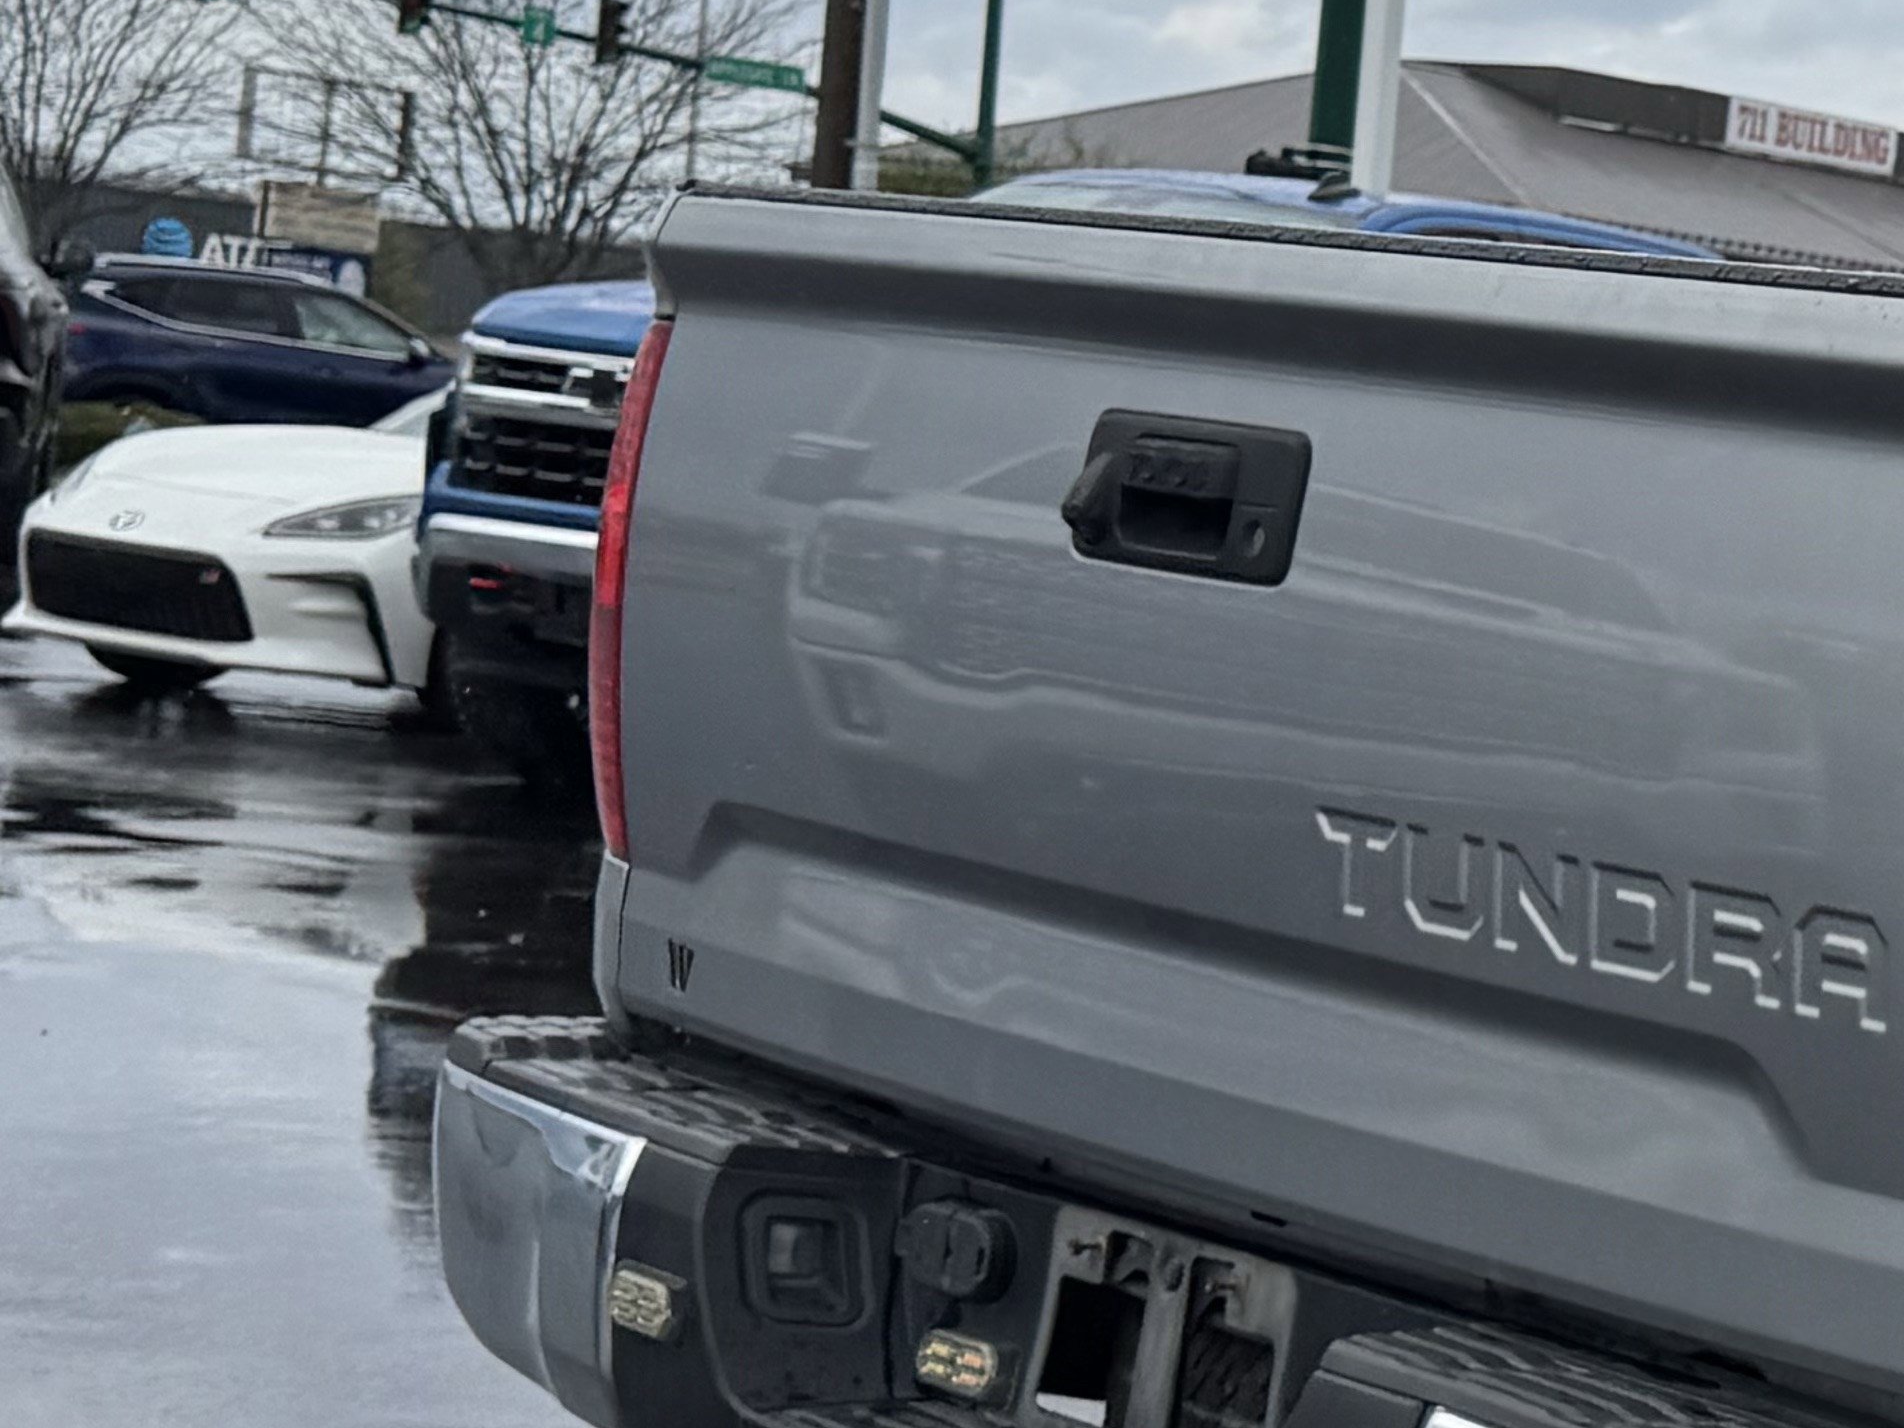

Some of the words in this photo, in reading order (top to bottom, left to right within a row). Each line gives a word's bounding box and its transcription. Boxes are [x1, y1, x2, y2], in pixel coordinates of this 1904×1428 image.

[1738, 104, 1768, 143] 711
[1774, 110, 1890, 166] BUILDING
[1313, 804, 1890, 1034] TUNDRA
